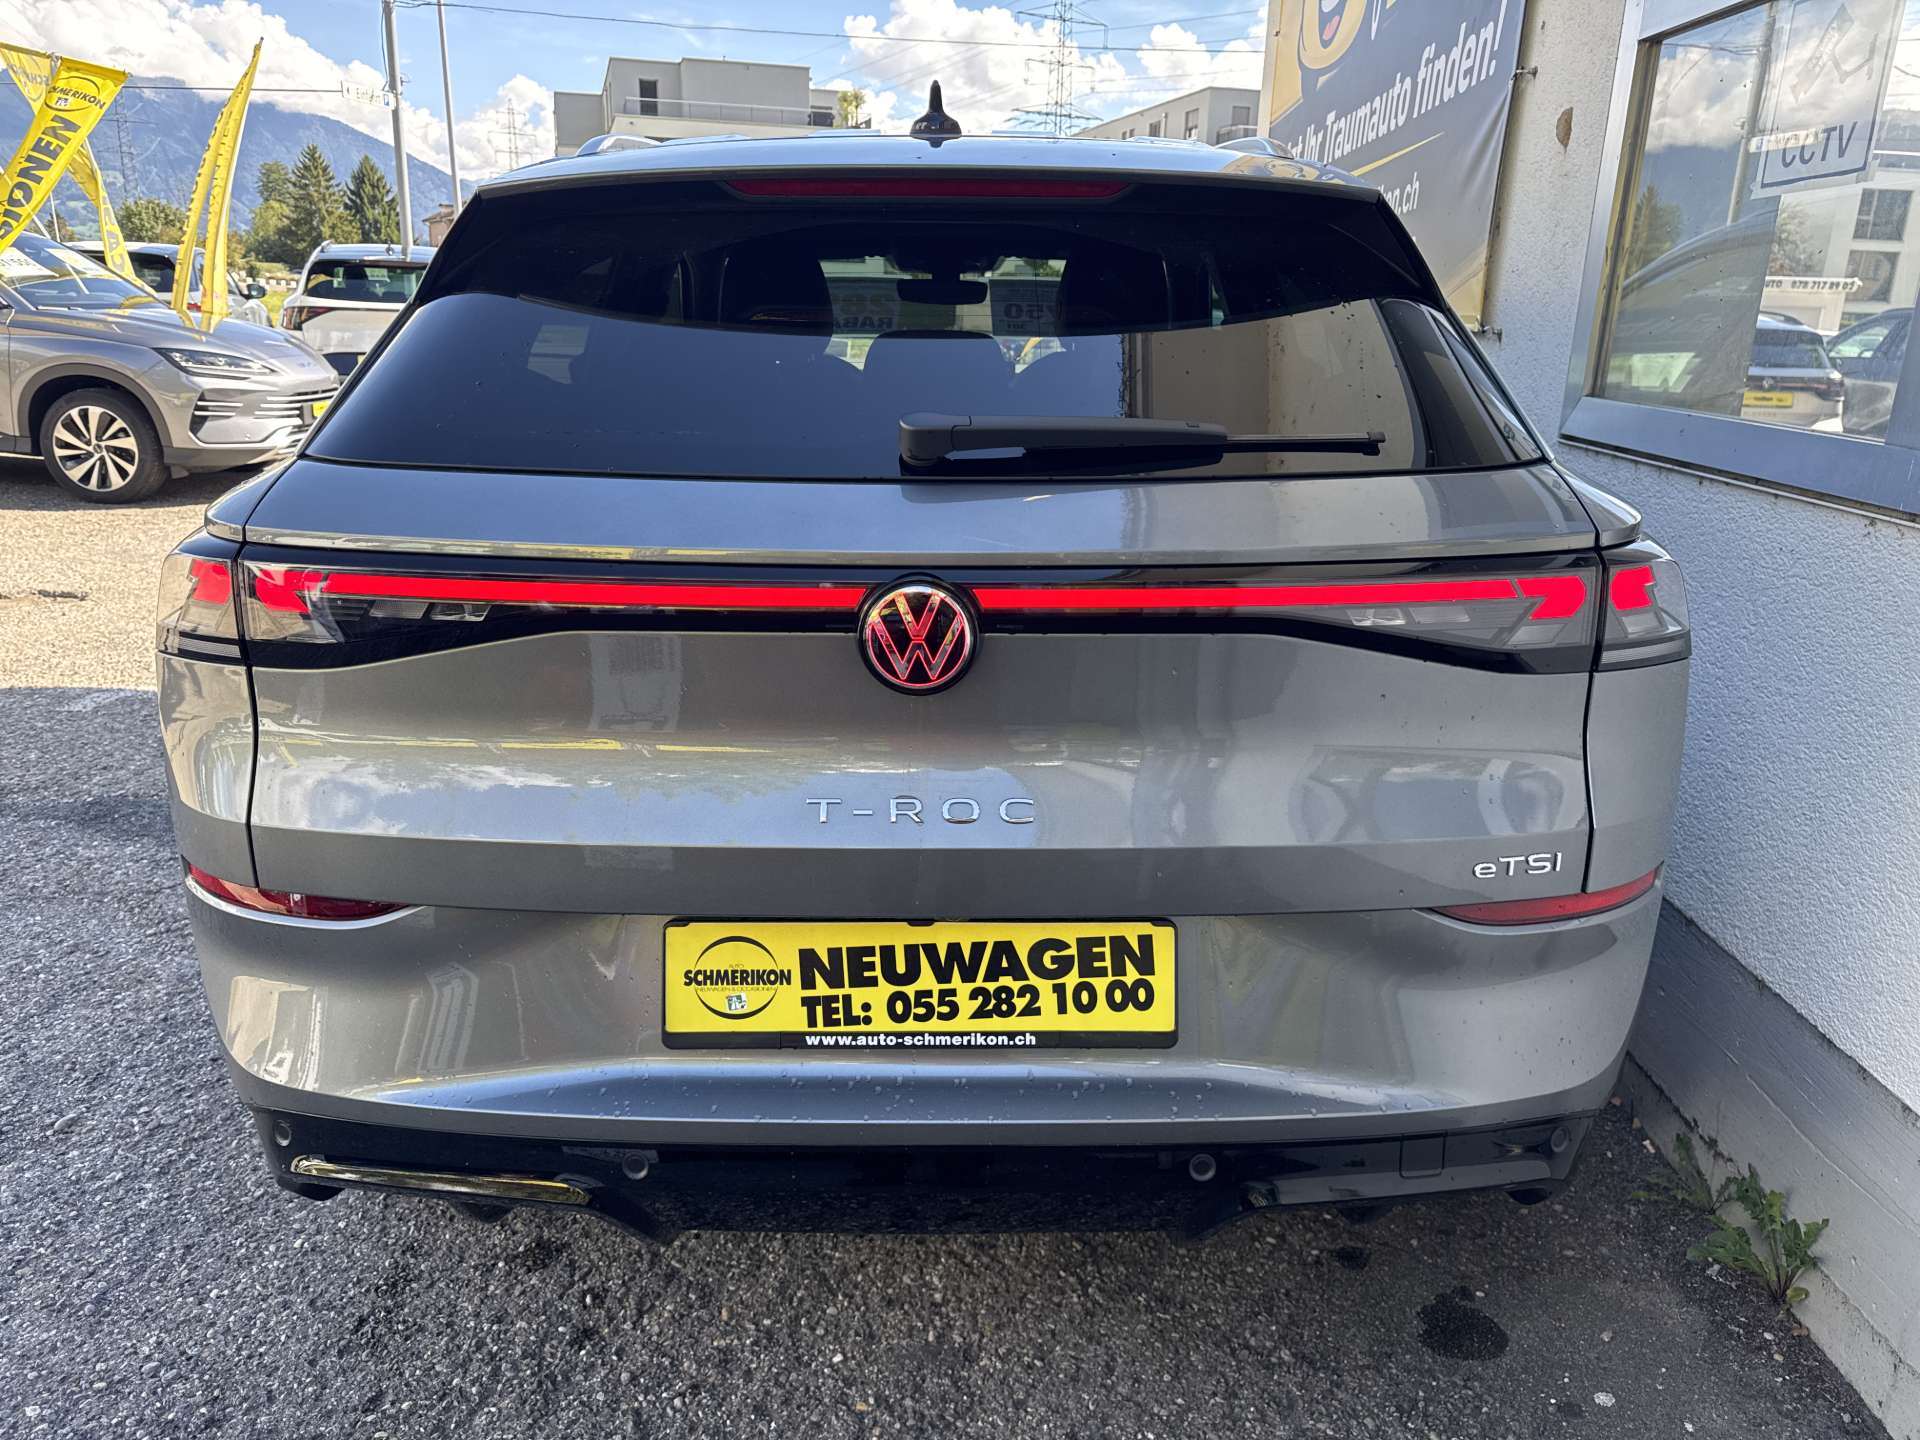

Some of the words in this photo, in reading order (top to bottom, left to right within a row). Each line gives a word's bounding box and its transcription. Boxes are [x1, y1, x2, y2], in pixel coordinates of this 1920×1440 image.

[1323, 72, 1412, 165] Traumauto
[1412, 0, 1508, 118] finden!
[1780, 121, 1858, 168] CCTV
[806, 796, 1035, 825] T-ROC
[1473, 851, 1563, 879] eTSI
[683, 969, 792, 987] SCHMERIKON
[799, 934, 1156, 990] NEUWAGEN
[801, 994, 872, 1028] TEL:
[887, 989, 960, 1023] 055
[968, 984, 1042, 1020] 282
[1053, 981, 1098, 1015] 10
[1106, 977, 1155, 1012] 00
[805, 1032, 1037, 1047] www.auto-schmerikon.ch
